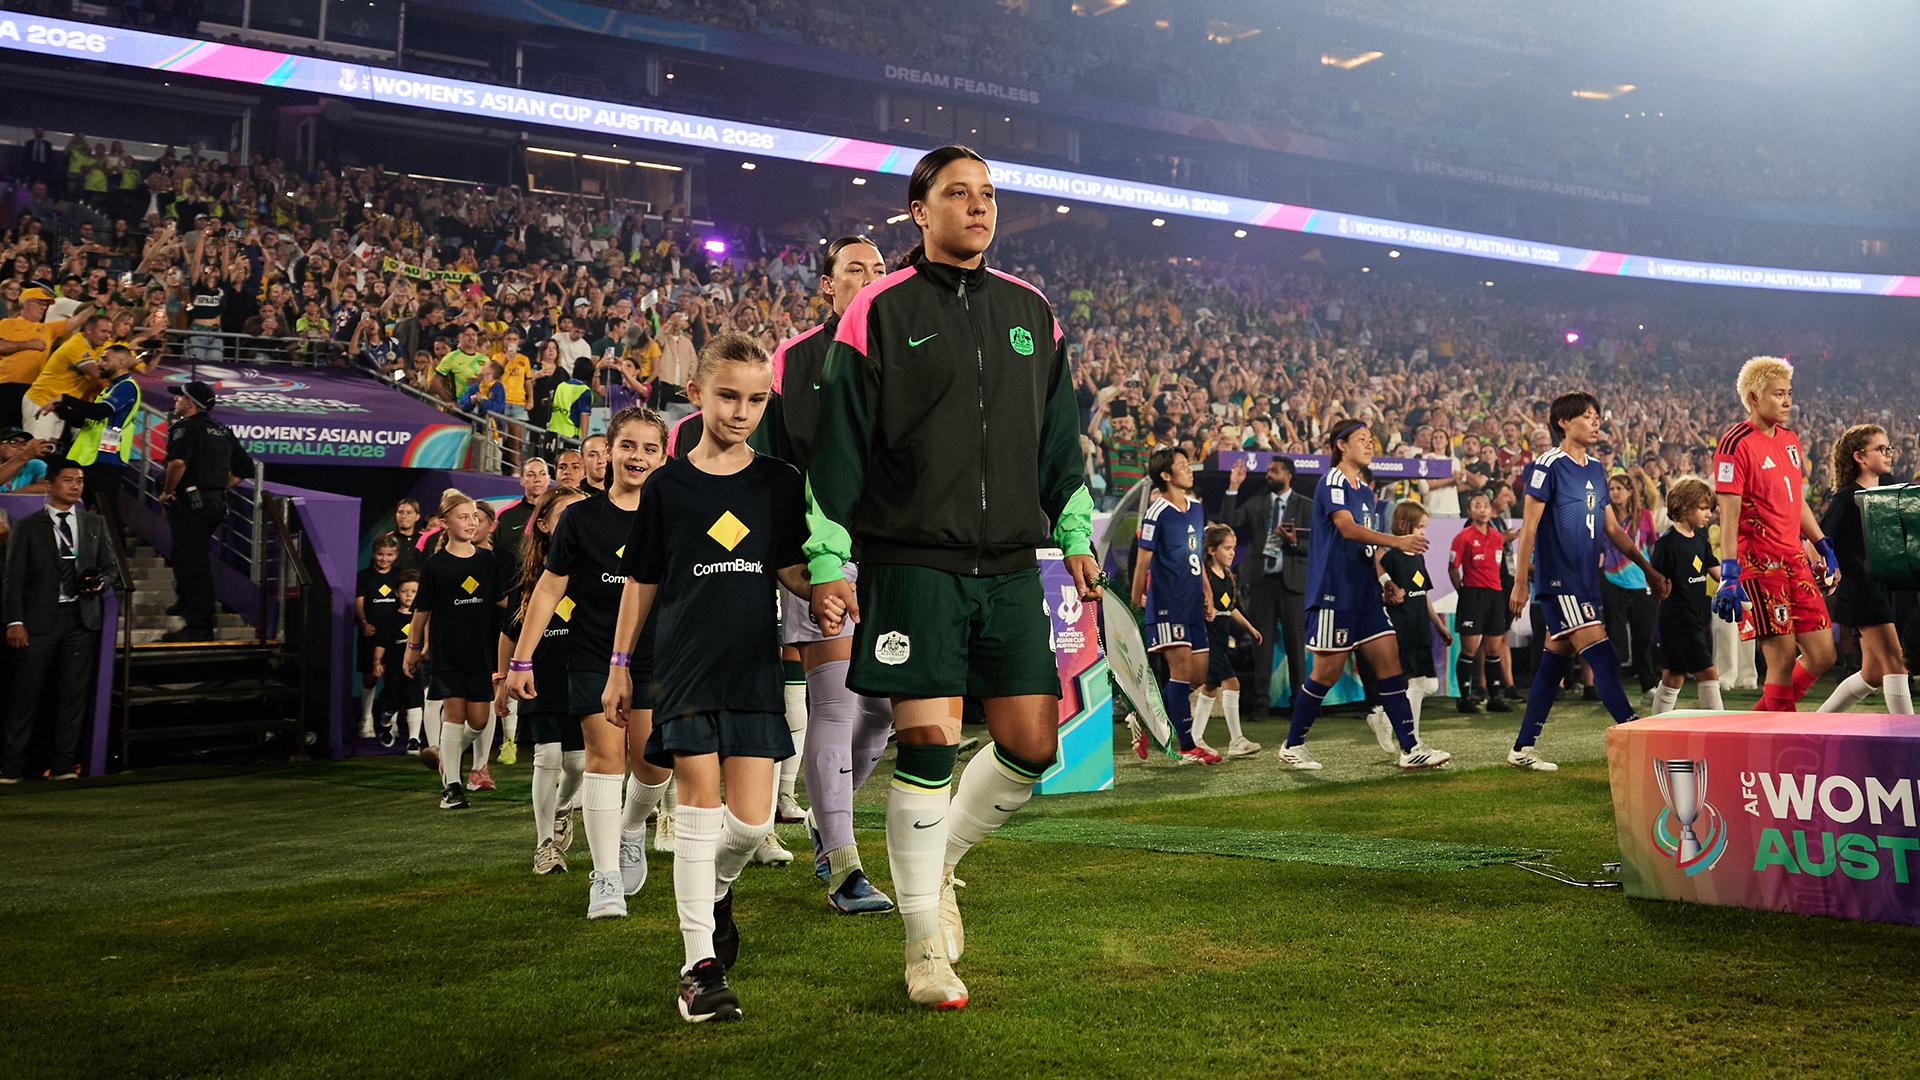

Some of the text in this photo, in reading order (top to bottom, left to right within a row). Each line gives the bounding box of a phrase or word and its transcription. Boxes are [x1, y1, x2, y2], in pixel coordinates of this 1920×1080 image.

[0, 20, 107, 53] A 2026
[884, 64, 1040, 104] DREAM FEARLESS
[372, 75, 476, 107] WOMEN'S
[479, 91, 546, 118] ASIAN
[548, 101, 592, 123] CUP
[593, 109, 719, 143] AUSTRALIA
[721, 127, 775, 149] 2026
[1024, 172, 1070, 193] ASIAN
[1071, 180, 1101, 196] CUP
[1102, 184, 1190, 210] AUSTRALIA
[1191, 197, 1230, 215] 2026
[1355, 222, 1407, 241] WOMEN'S
[1408, 230, 1442, 246] ASIAN
[1443, 234, 1466, 248] CUP
[1466, 238, 1530, 259] AUSTRALIA
[1709, 268, 1741, 282] ASIAN
[1742, 271, 1764, 284] CUP
[1764, 273, 1830, 288] AUSTRALIA
[231, 424, 411, 445] WOMEN'S ASIAN CUP
[337, 444, 386, 458] 2026
[1783, 475, 1794, 503] 1
[1585, 513, 1595, 539] 4
[693, 558, 763, 577] CommBank
[1188, 553, 1201, 576] 9
[544, 628, 569, 638] Comm
[1740, 771, 1920, 827] AFC WOM
[1753, 827, 1920, 884] AUST
